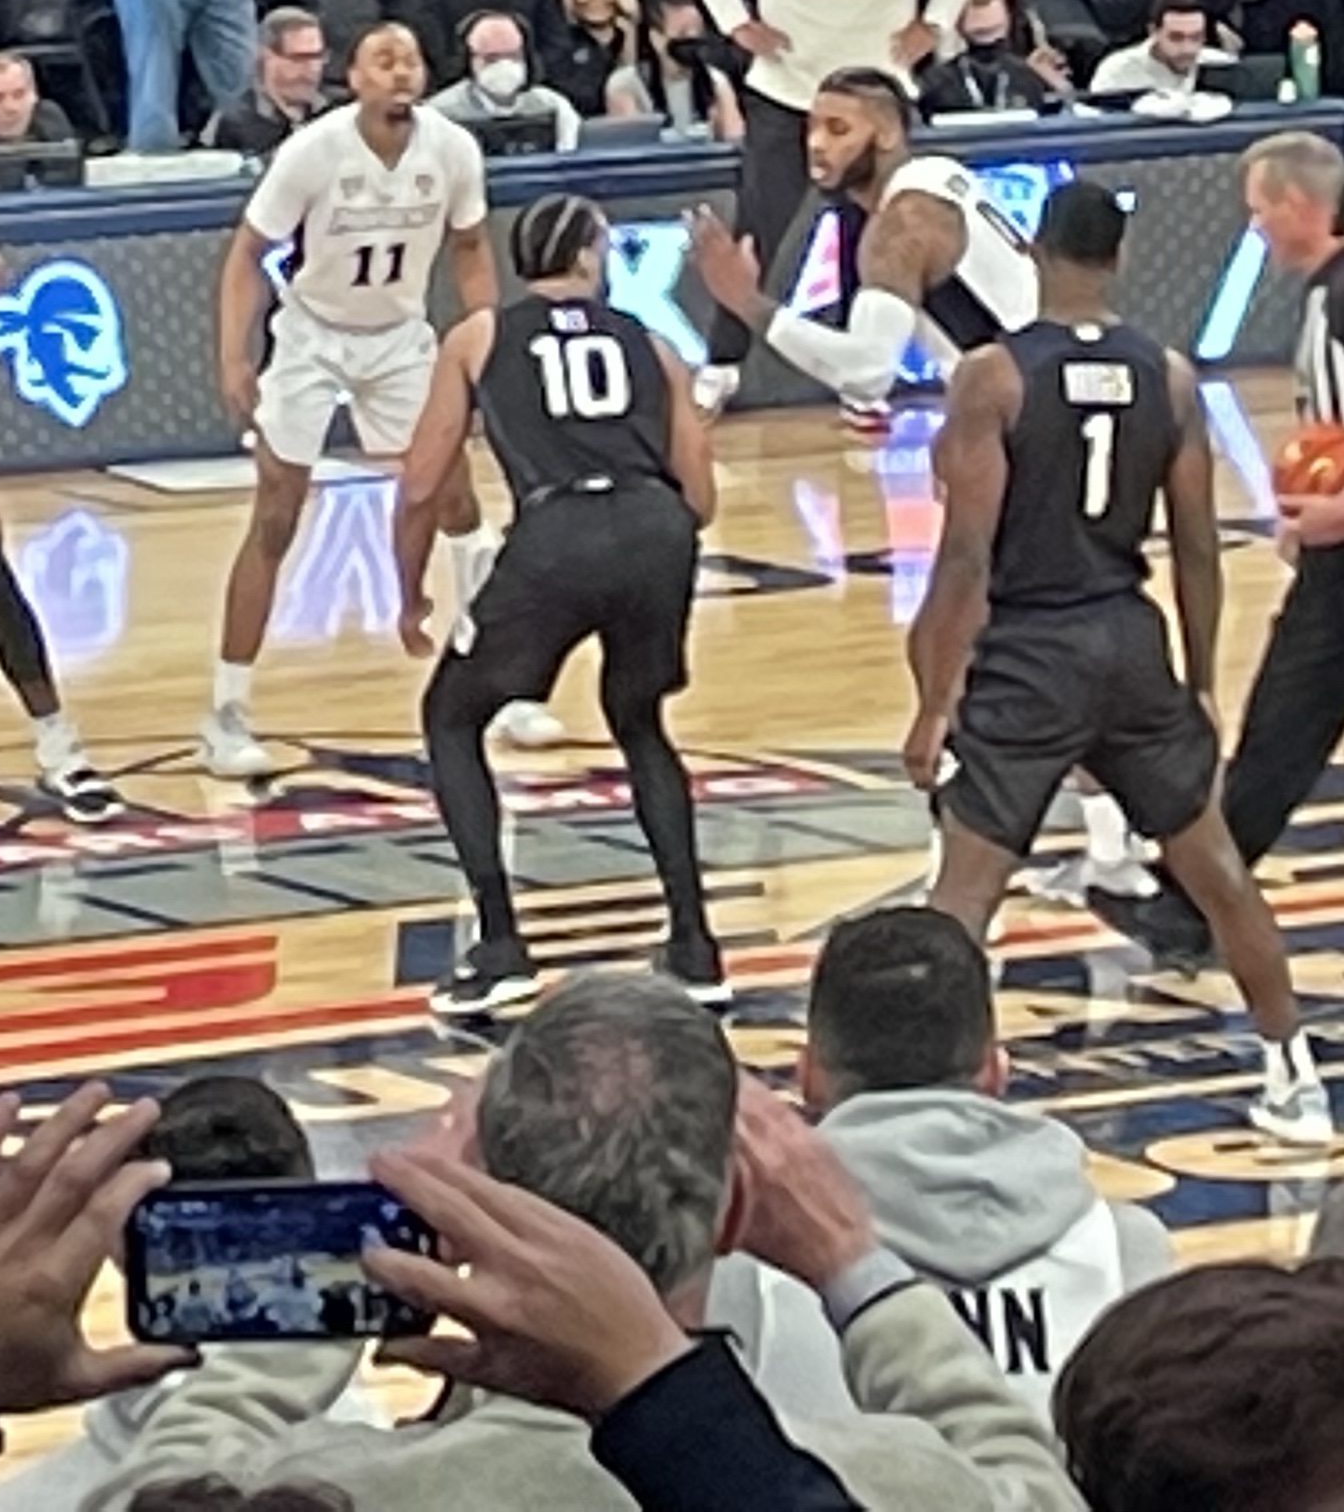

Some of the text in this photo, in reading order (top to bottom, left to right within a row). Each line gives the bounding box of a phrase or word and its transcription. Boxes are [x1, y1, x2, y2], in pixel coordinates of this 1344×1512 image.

[350, 242, 407, 287] 11
[529, 335, 631, 419] 10
[1082, 413, 1114, 518] 1
